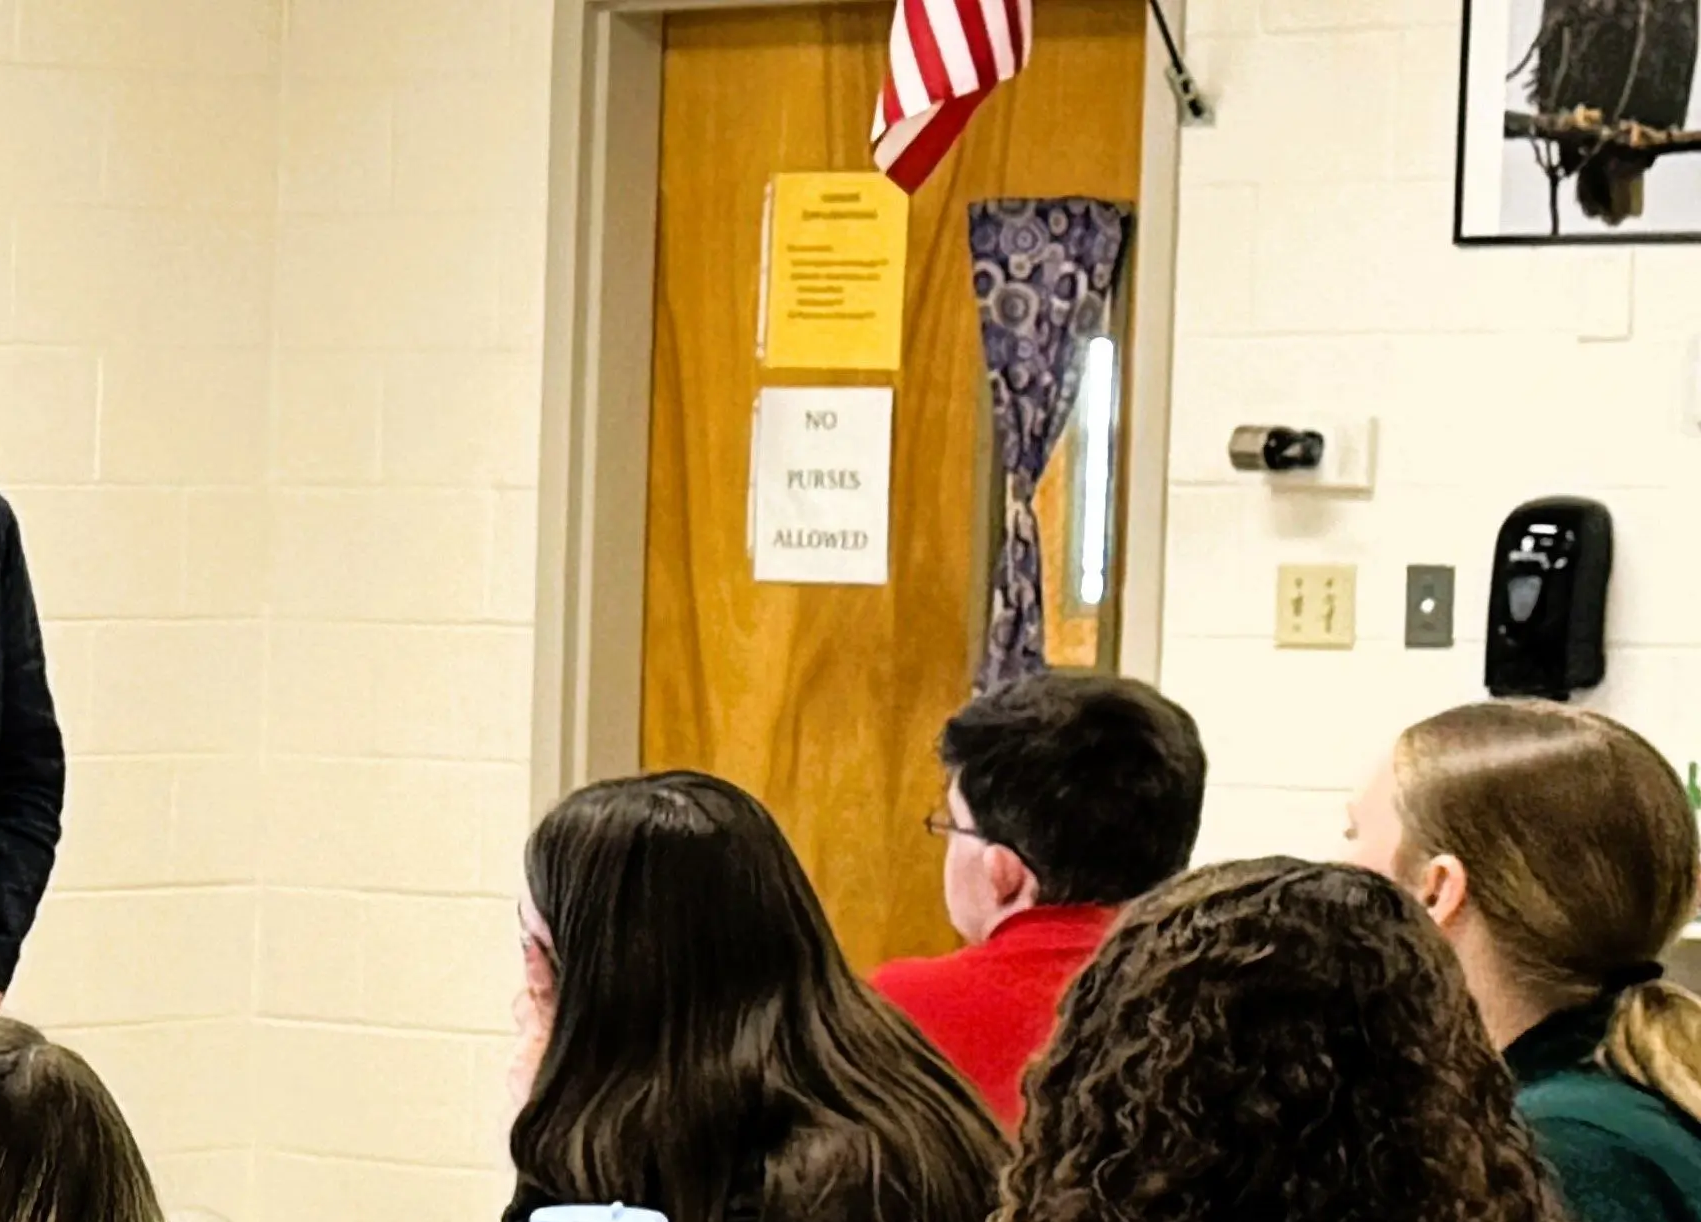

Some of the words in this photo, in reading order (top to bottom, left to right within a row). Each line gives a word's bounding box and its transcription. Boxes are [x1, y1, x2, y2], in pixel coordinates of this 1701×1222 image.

[805, 411, 838, 431] NO
[787, 470, 861, 491] PURSES
[773, 530, 868, 552] ALLOWED
